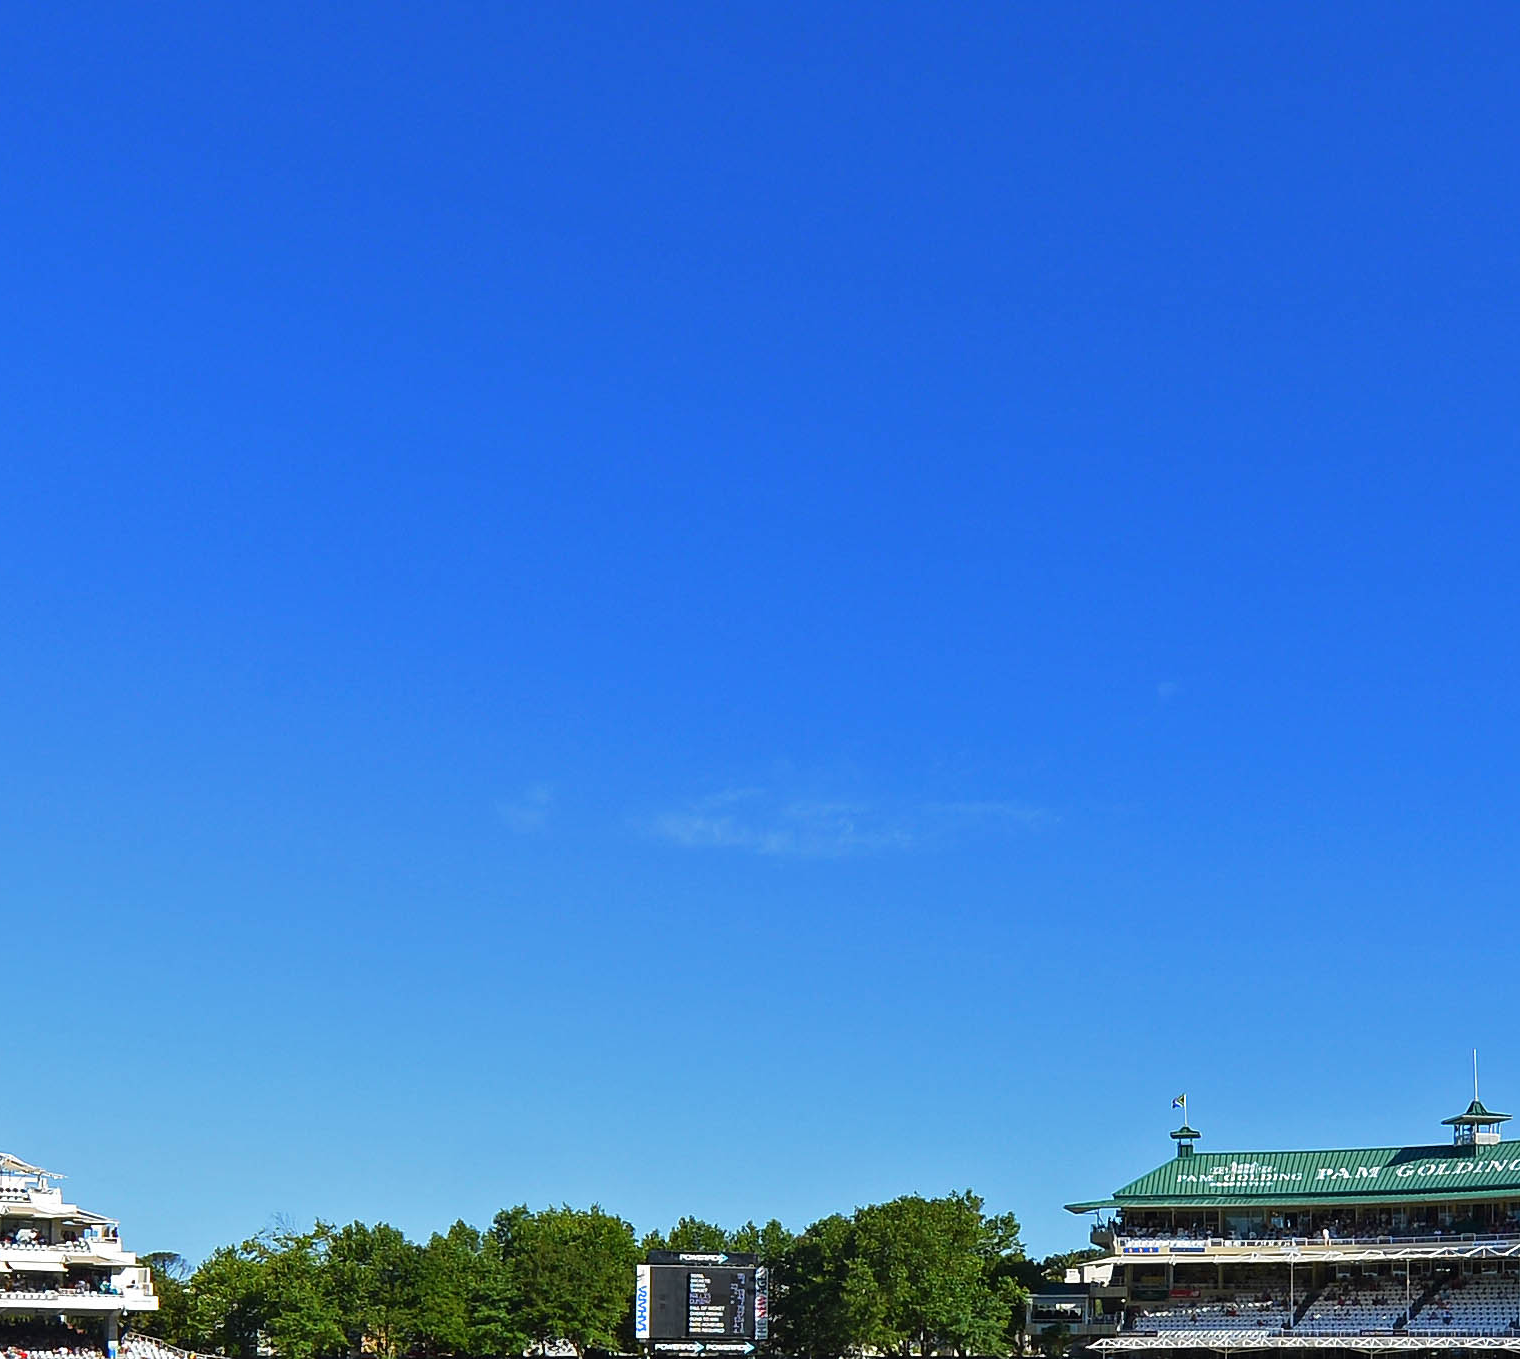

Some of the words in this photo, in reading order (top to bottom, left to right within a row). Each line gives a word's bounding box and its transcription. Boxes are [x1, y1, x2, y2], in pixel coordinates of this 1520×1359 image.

[1177, 1174, 1214, 1183] PAM
[1224, 1173, 1302, 1182] GOLDING
[1316, 1165, 1381, 1180] PAM
[637, 1285, 648, 1332] SAHARA
